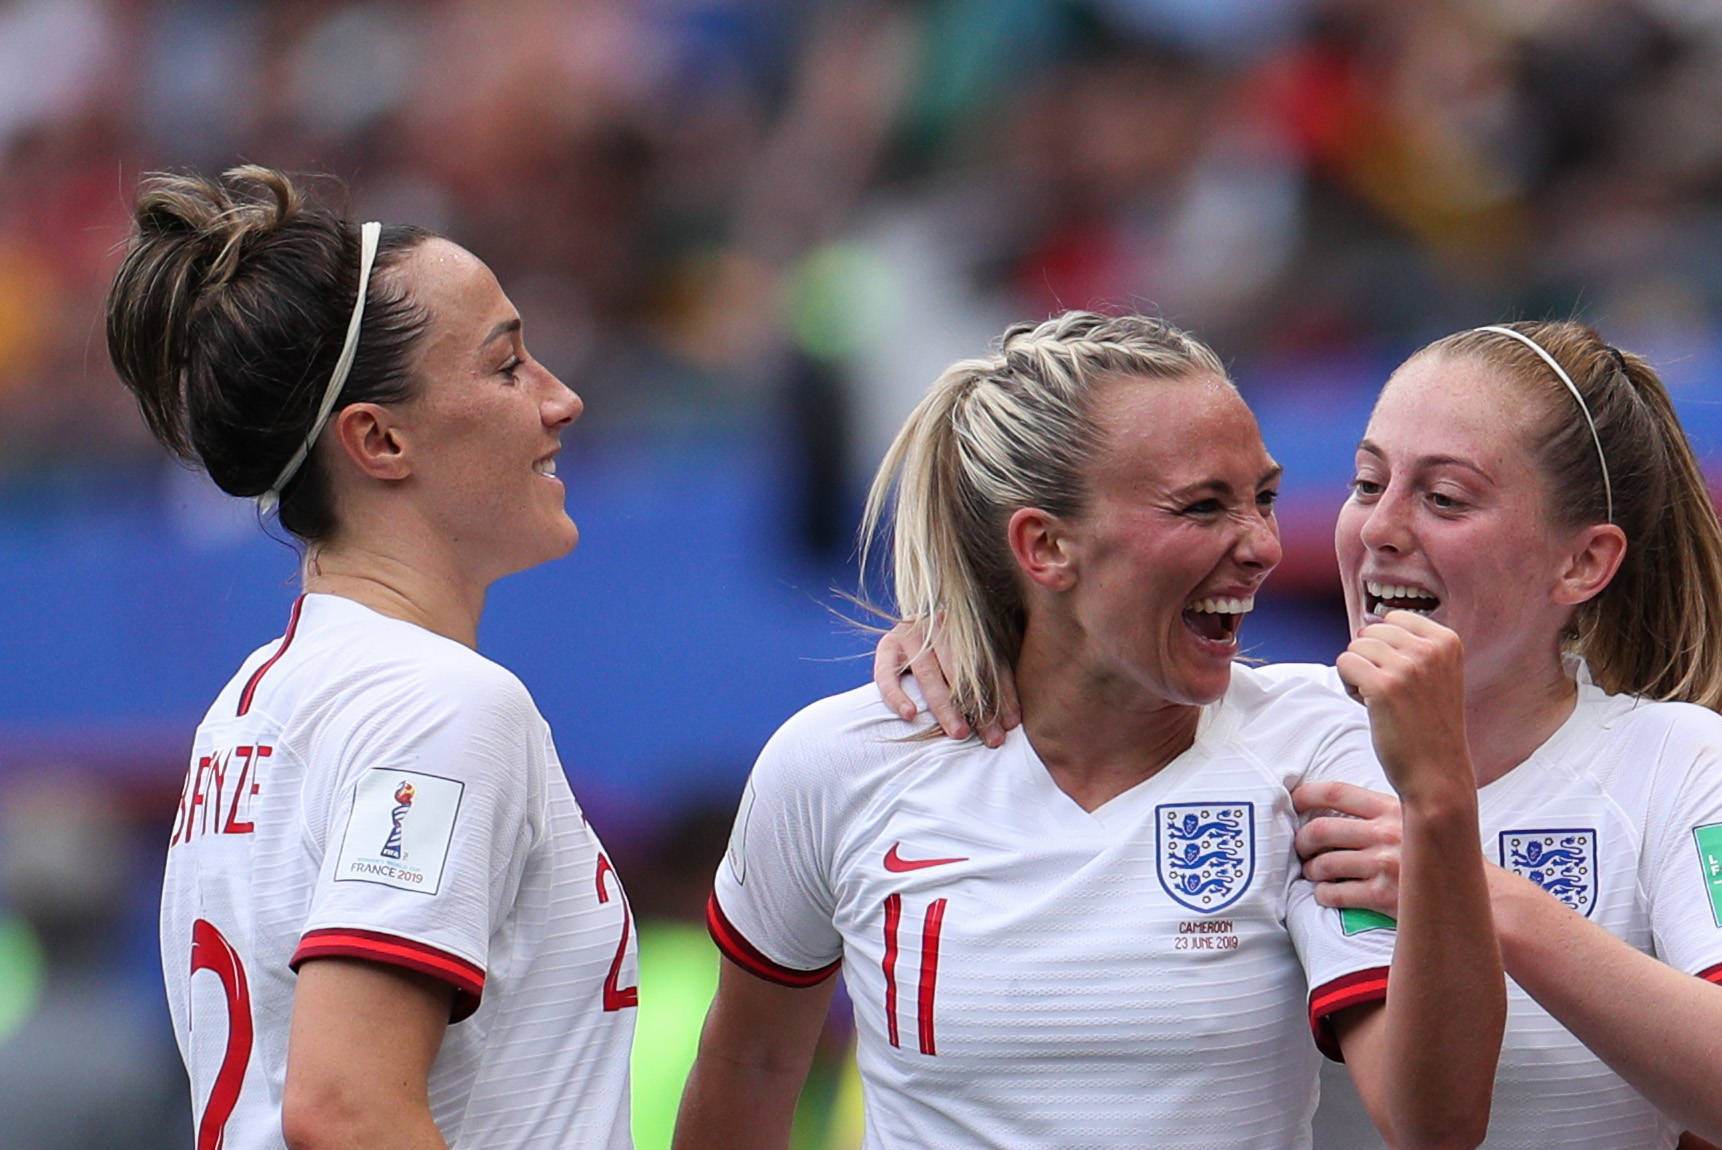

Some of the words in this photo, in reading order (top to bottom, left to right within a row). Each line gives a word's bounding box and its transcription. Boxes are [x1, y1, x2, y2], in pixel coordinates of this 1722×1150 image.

[350, 862, 397, 878] FRANCE
[397, 869, 424, 884] 2019
[1179, 920, 1233, 934] CAMEROON
[1174, 936, 1189, 950] 23
[1191, 936, 1215, 950] JUNE
[1216, 935, 1239, 950] 2019
[882, 892, 948, 1057] 11
